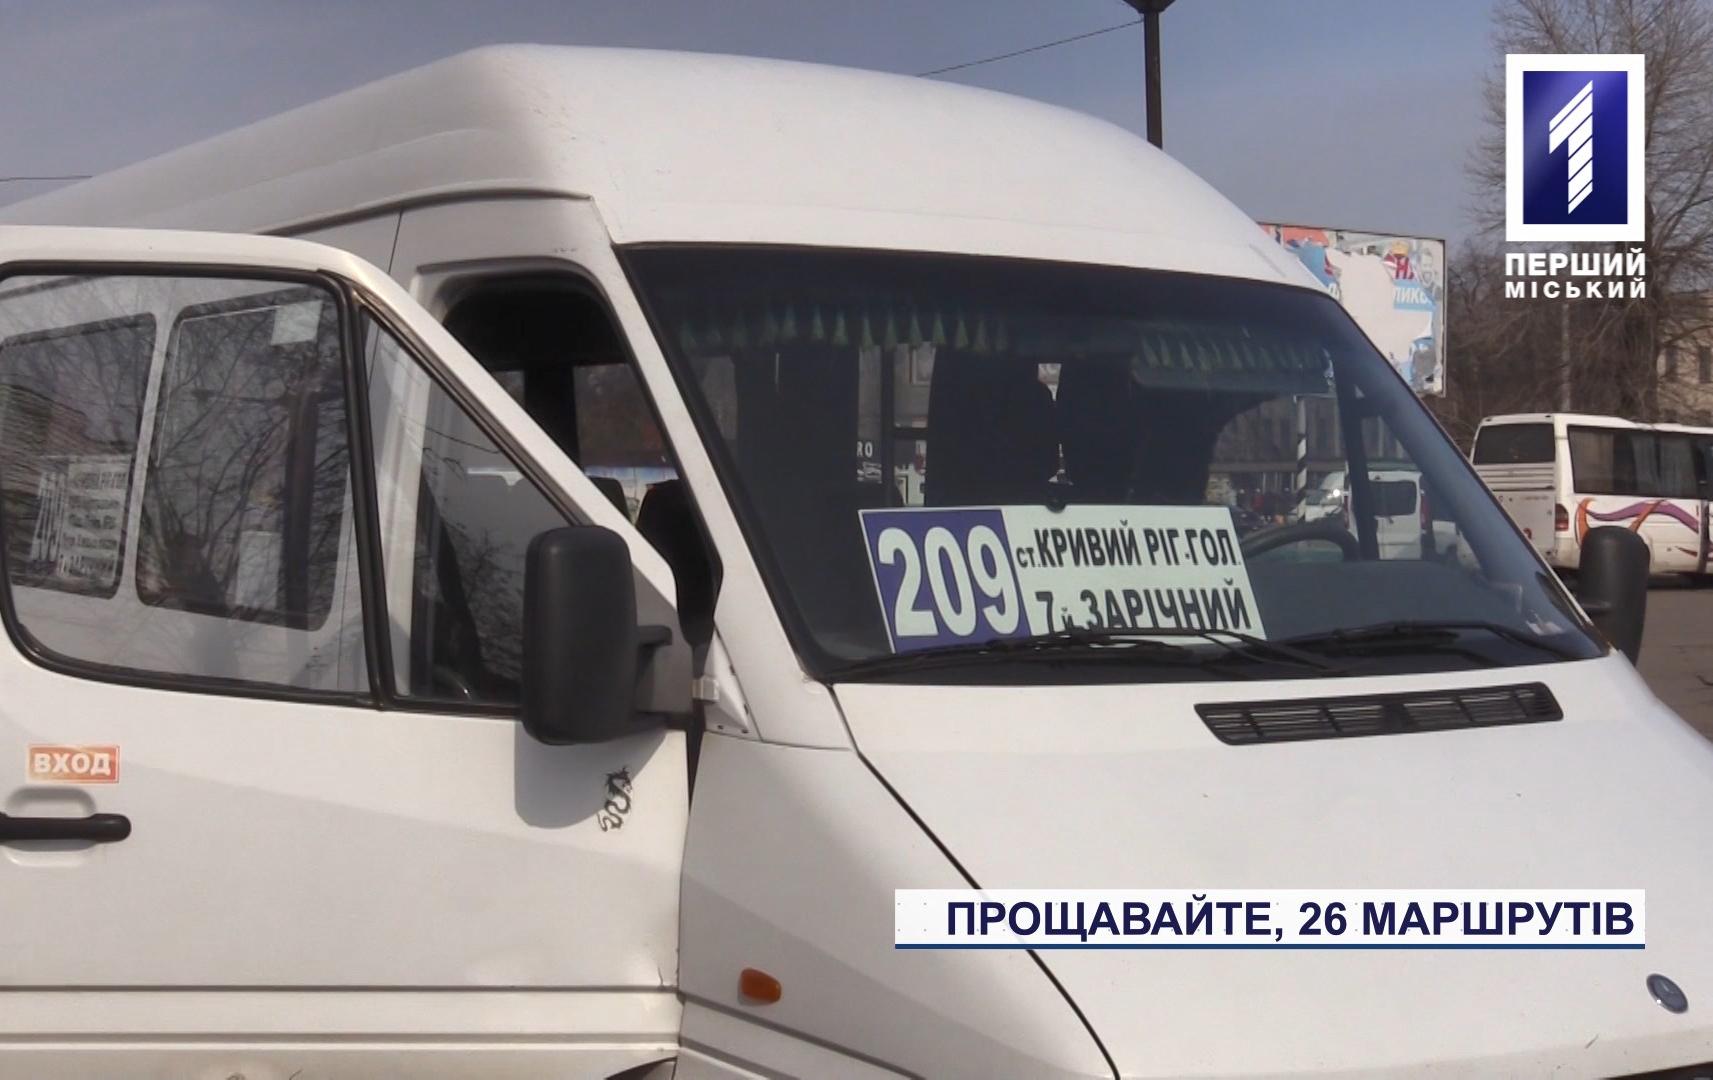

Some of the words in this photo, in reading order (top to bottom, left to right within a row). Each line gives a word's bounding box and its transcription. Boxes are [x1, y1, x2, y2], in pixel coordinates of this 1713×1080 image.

[878, 524, 1020, 637] 209
[1080, 577, 1252, 632] ЗАРІЧНИЙ
[34, 752, 112, 776] ВХОД
